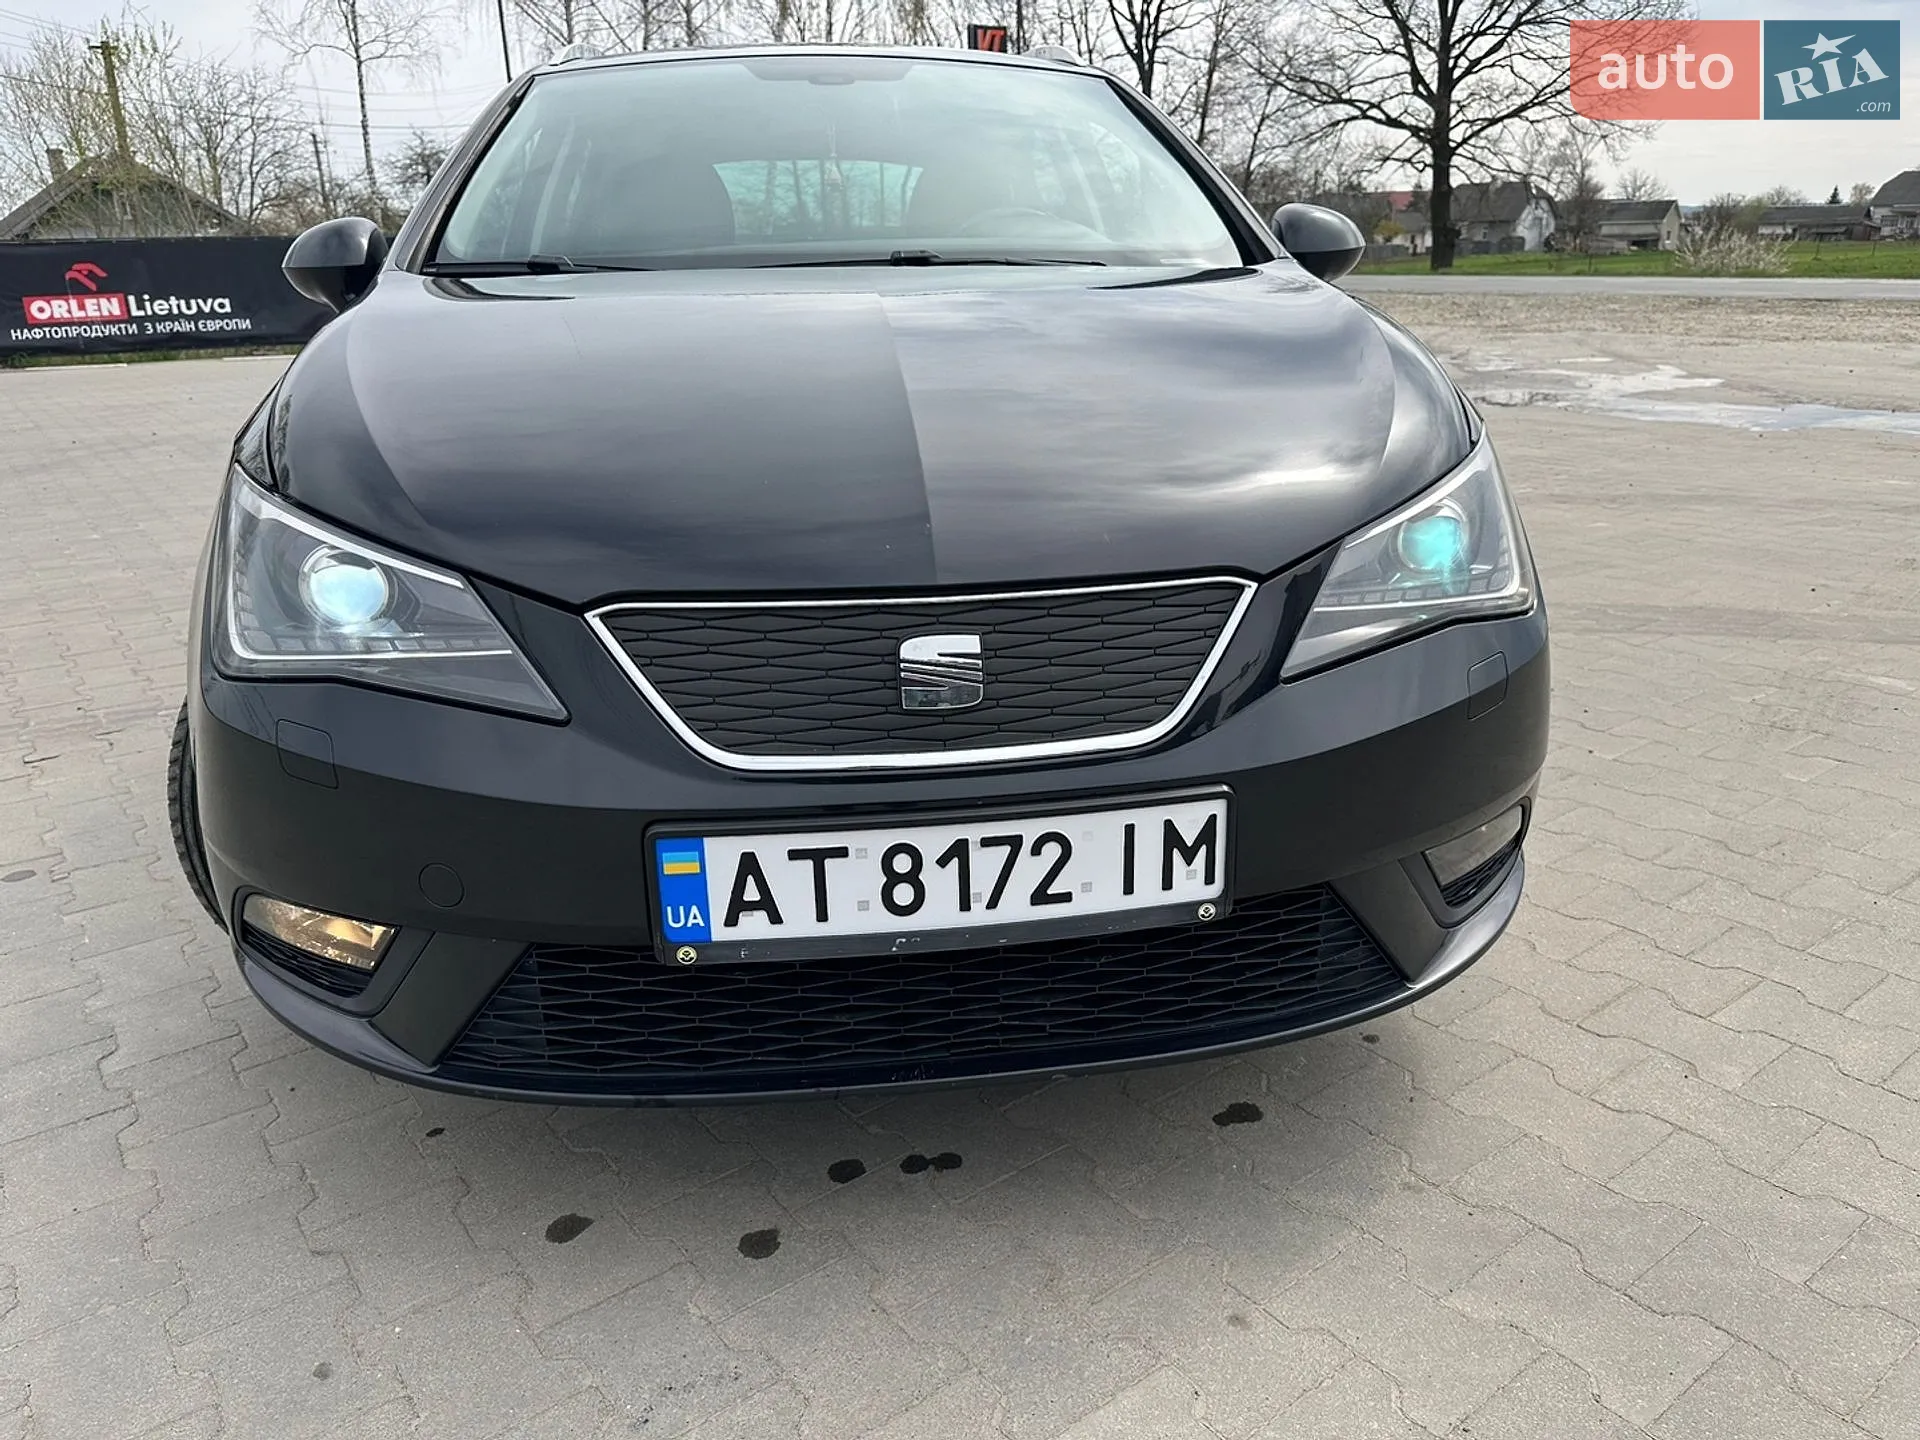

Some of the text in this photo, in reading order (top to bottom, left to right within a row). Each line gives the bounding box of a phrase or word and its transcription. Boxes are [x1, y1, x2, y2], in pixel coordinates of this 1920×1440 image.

[29, 294, 232, 320] ORLEN Lietuva
[10, 322, 138, 341] НАФТОПРОДУКТИ
[156, 319, 195, 333] КРАЇН
[198, 318, 251, 332] ЄВРОПИ
[723, 812, 1218, 928] AT 8172 IM
[667, 906, 704, 929] UA
